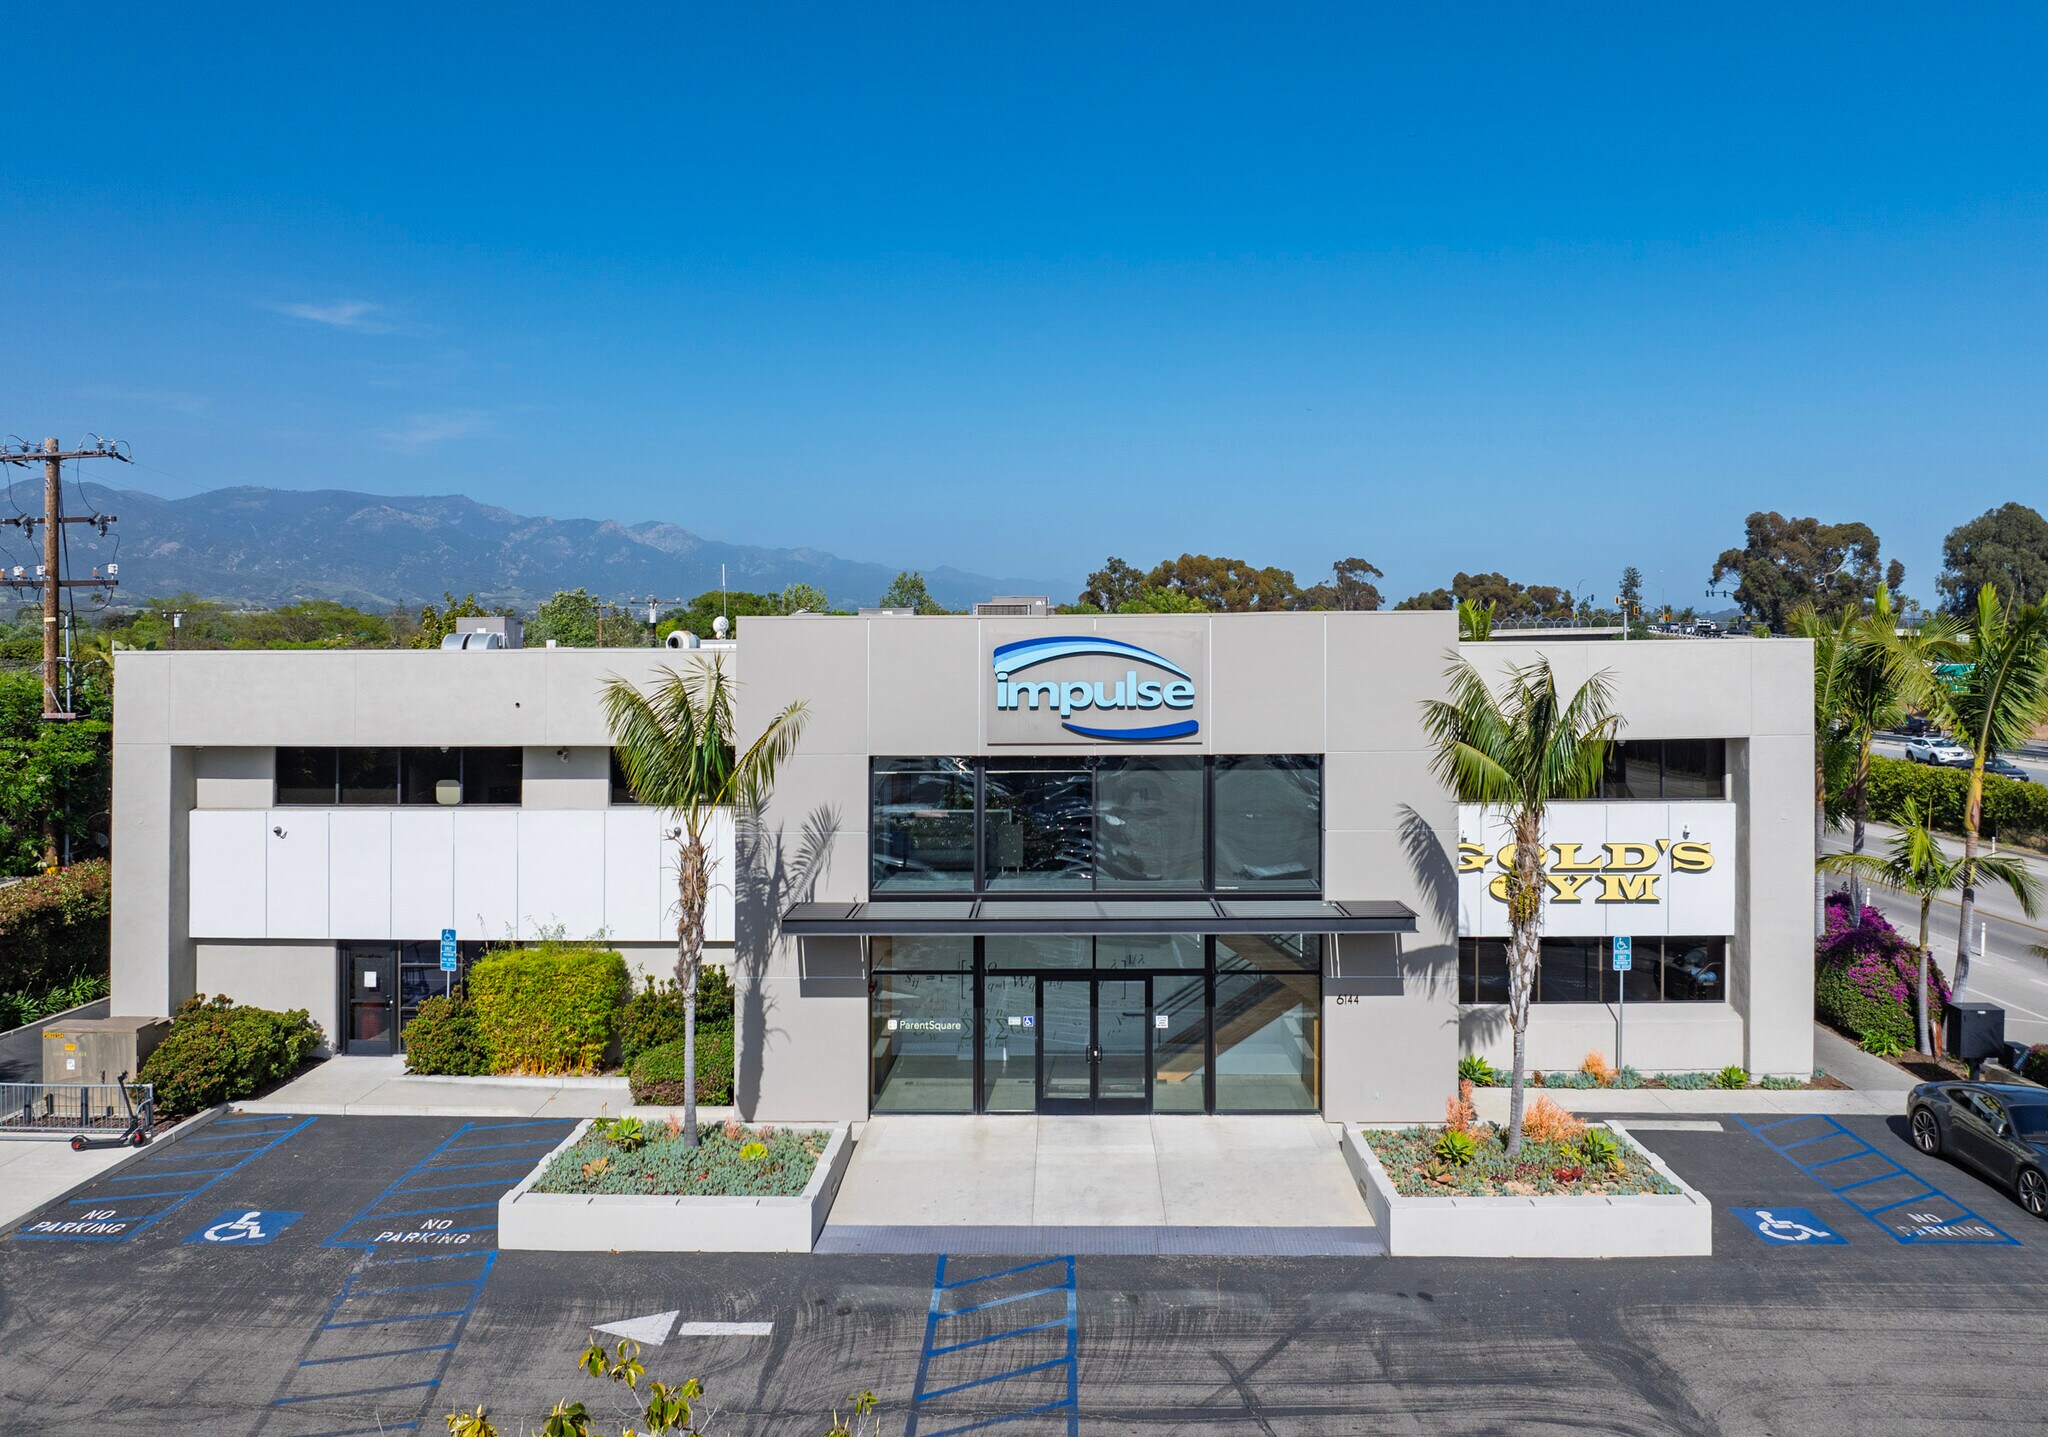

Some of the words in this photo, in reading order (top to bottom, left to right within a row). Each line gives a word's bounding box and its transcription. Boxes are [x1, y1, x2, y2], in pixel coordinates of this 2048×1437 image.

[997, 670, 1196, 718] impulse
[1336, 994, 1359, 1006] 6144
[900, 1020, 961, 1031] ParentSquare
[80, 1209, 117, 1220] NO
[1906, 1213, 1944, 1223] NO
[28, 1221, 127, 1234] PARKING
[420, 1218, 453, 1230] NO
[1896, 1225, 1996, 1237] PARKING
[374, 1231, 471, 1244] PARKING
